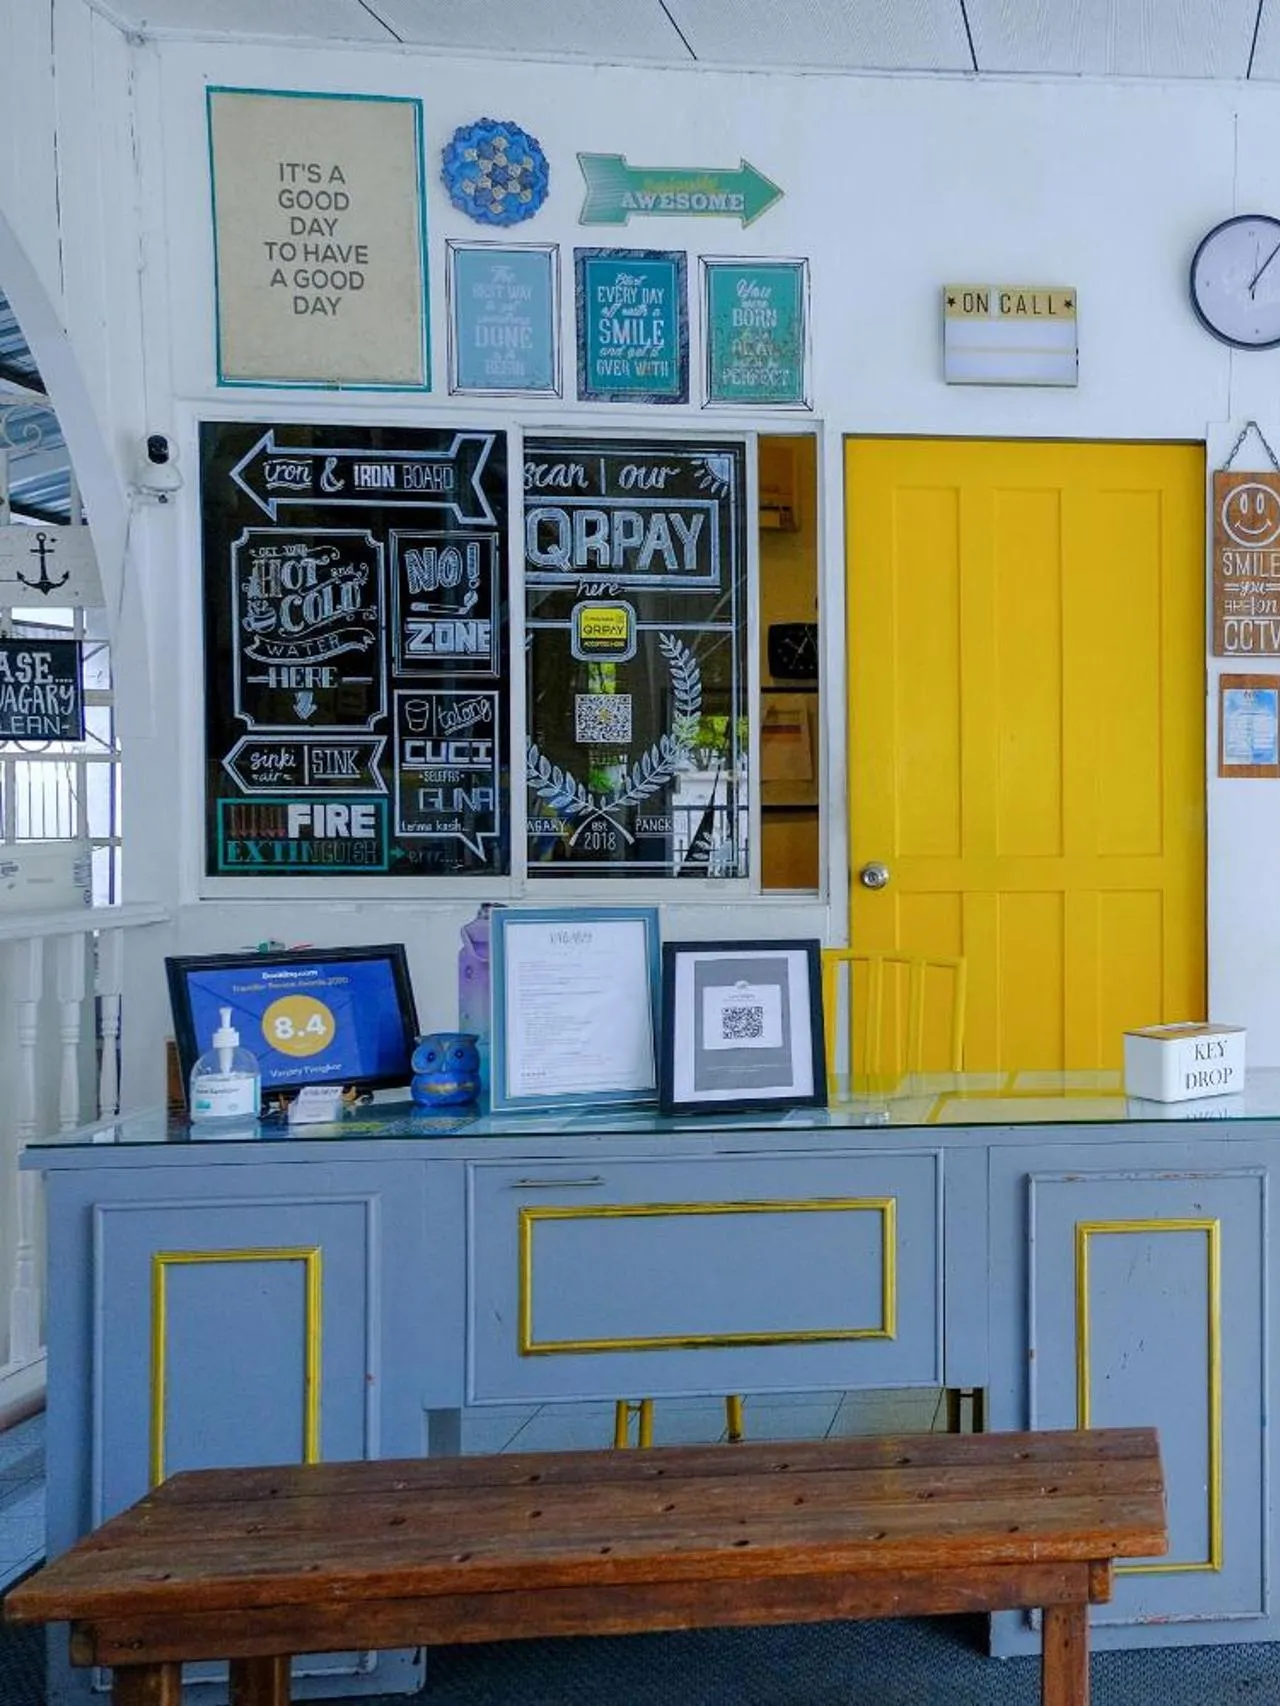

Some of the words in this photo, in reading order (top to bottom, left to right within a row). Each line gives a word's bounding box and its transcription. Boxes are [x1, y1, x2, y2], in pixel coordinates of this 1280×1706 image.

[279, 163, 322, 183] IT'S
[328, 165, 346, 185] A
[278, 189, 349, 211] GOOD
[621, 192, 745, 211] AWESOME
[290, 216, 338, 237] DAY
[264, 241, 296, 262] TO
[303, 243, 368, 264] HAVE
[270, 268, 288, 287] A
[293, 268, 364, 290] GOOD
[736, 278, 771, 299] You
[294, 295, 342, 315] DAY
[598, 286, 638, 304] EVERY
[642, 288, 665, 305] DAY
[963, 292, 989, 313] ON
[1000, 294, 1057, 315] CALL
[733, 308, 777, 328] BORN
[474, 325, 533, 350] DONE
[599, 318, 664, 345] SMILE
[597, 359, 629, 376] OVER
[634, 360, 668, 377] WITH
[263, 463, 313, 483] iron
[354, 465, 395, 487] IRON
[403, 465, 454, 489] BOARD
[619, 463, 681, 488] our
[526, 507, 705, 572] QRPAY
[248, 558, 329, 598] HOT
[576, 577, 626, 597] here
[280, 581, 361, 632] COLD
[266, 634, 340, 656] WATER
[405, 622, 490, 654] ZONE
[268, 667, 338, 688] HERE
[438, 699, 492, 729] tolong
[250, 747, 296, 770] sinki
[312, 750, 360, 774] SINK
[405, 740, 492, 763] CUCI
[419, 787, 493, 813] GUNA
[287, 804, 375, 838] FIRE
[585, 832, 616, 851] 2018
[275, 1014, 327, 1040] 8.4
[1195, 1040, 1227, 1060] KEY
[1186, 1067, 1233, 1090] DROP
